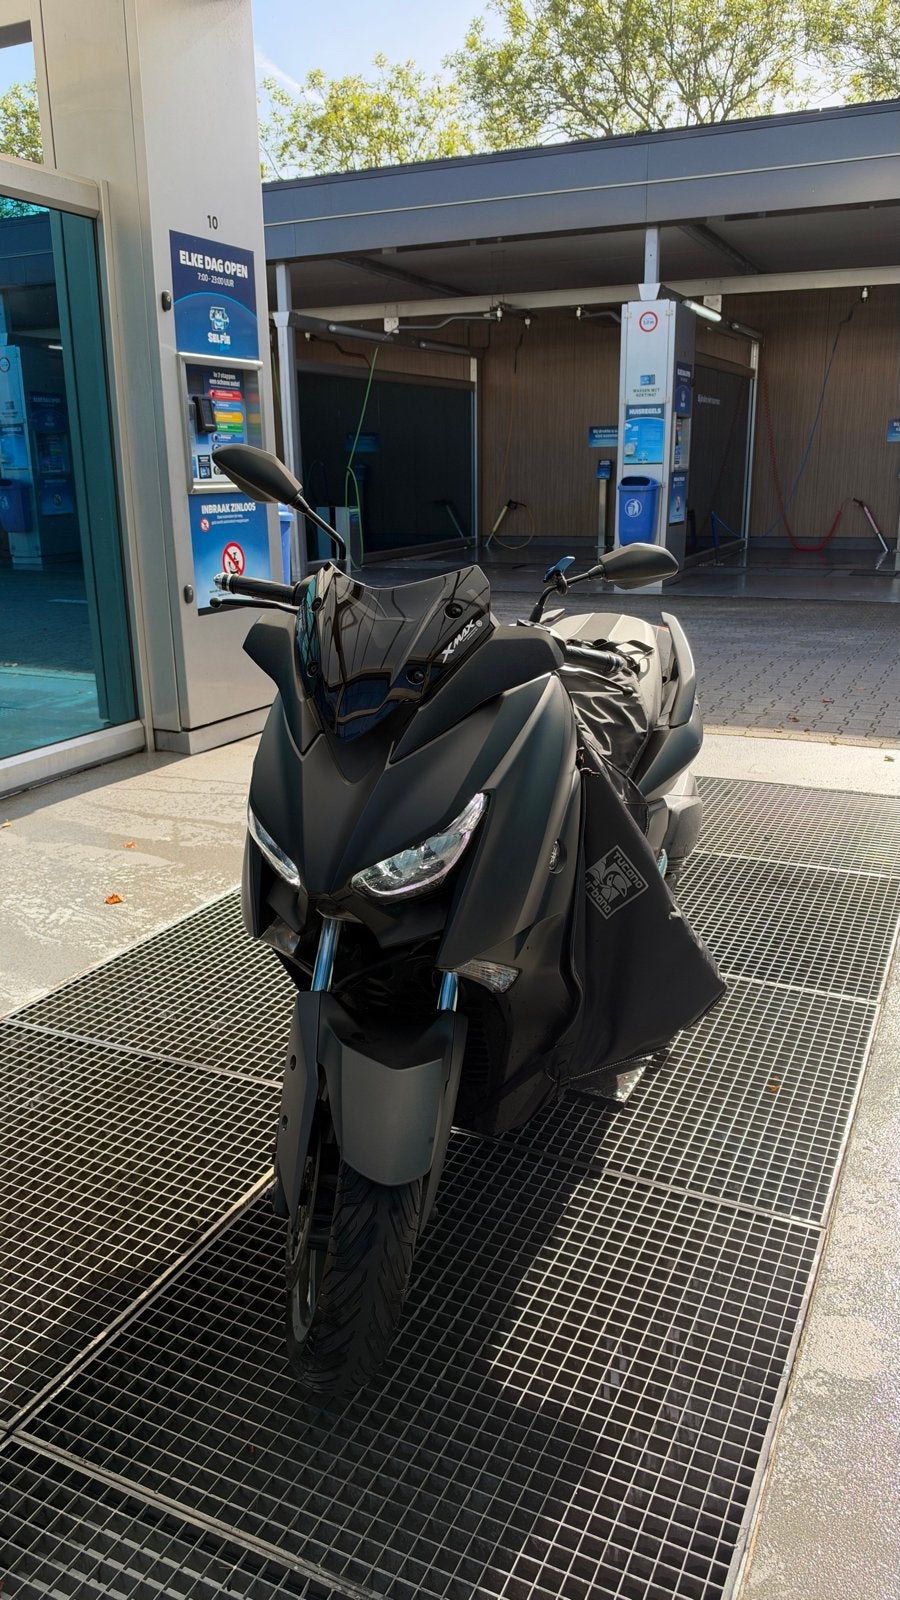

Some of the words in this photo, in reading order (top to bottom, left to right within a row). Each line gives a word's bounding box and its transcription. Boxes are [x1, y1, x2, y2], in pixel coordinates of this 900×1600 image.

[207, 215, 218, 230] 10
[179, 250, 204, 268] ELKE
[204, 255, 224, 272] DAG
[224, 262, 249, 279] OPEN
[197, 272, 209, 283] 7:00
[224, 277, 235, 288] UUR
[629, 407, 662, 415] HUISREGELS
[201, 503, 231, 515] INBRAAK
[230, 502, 256, 512] ZINLOOS
